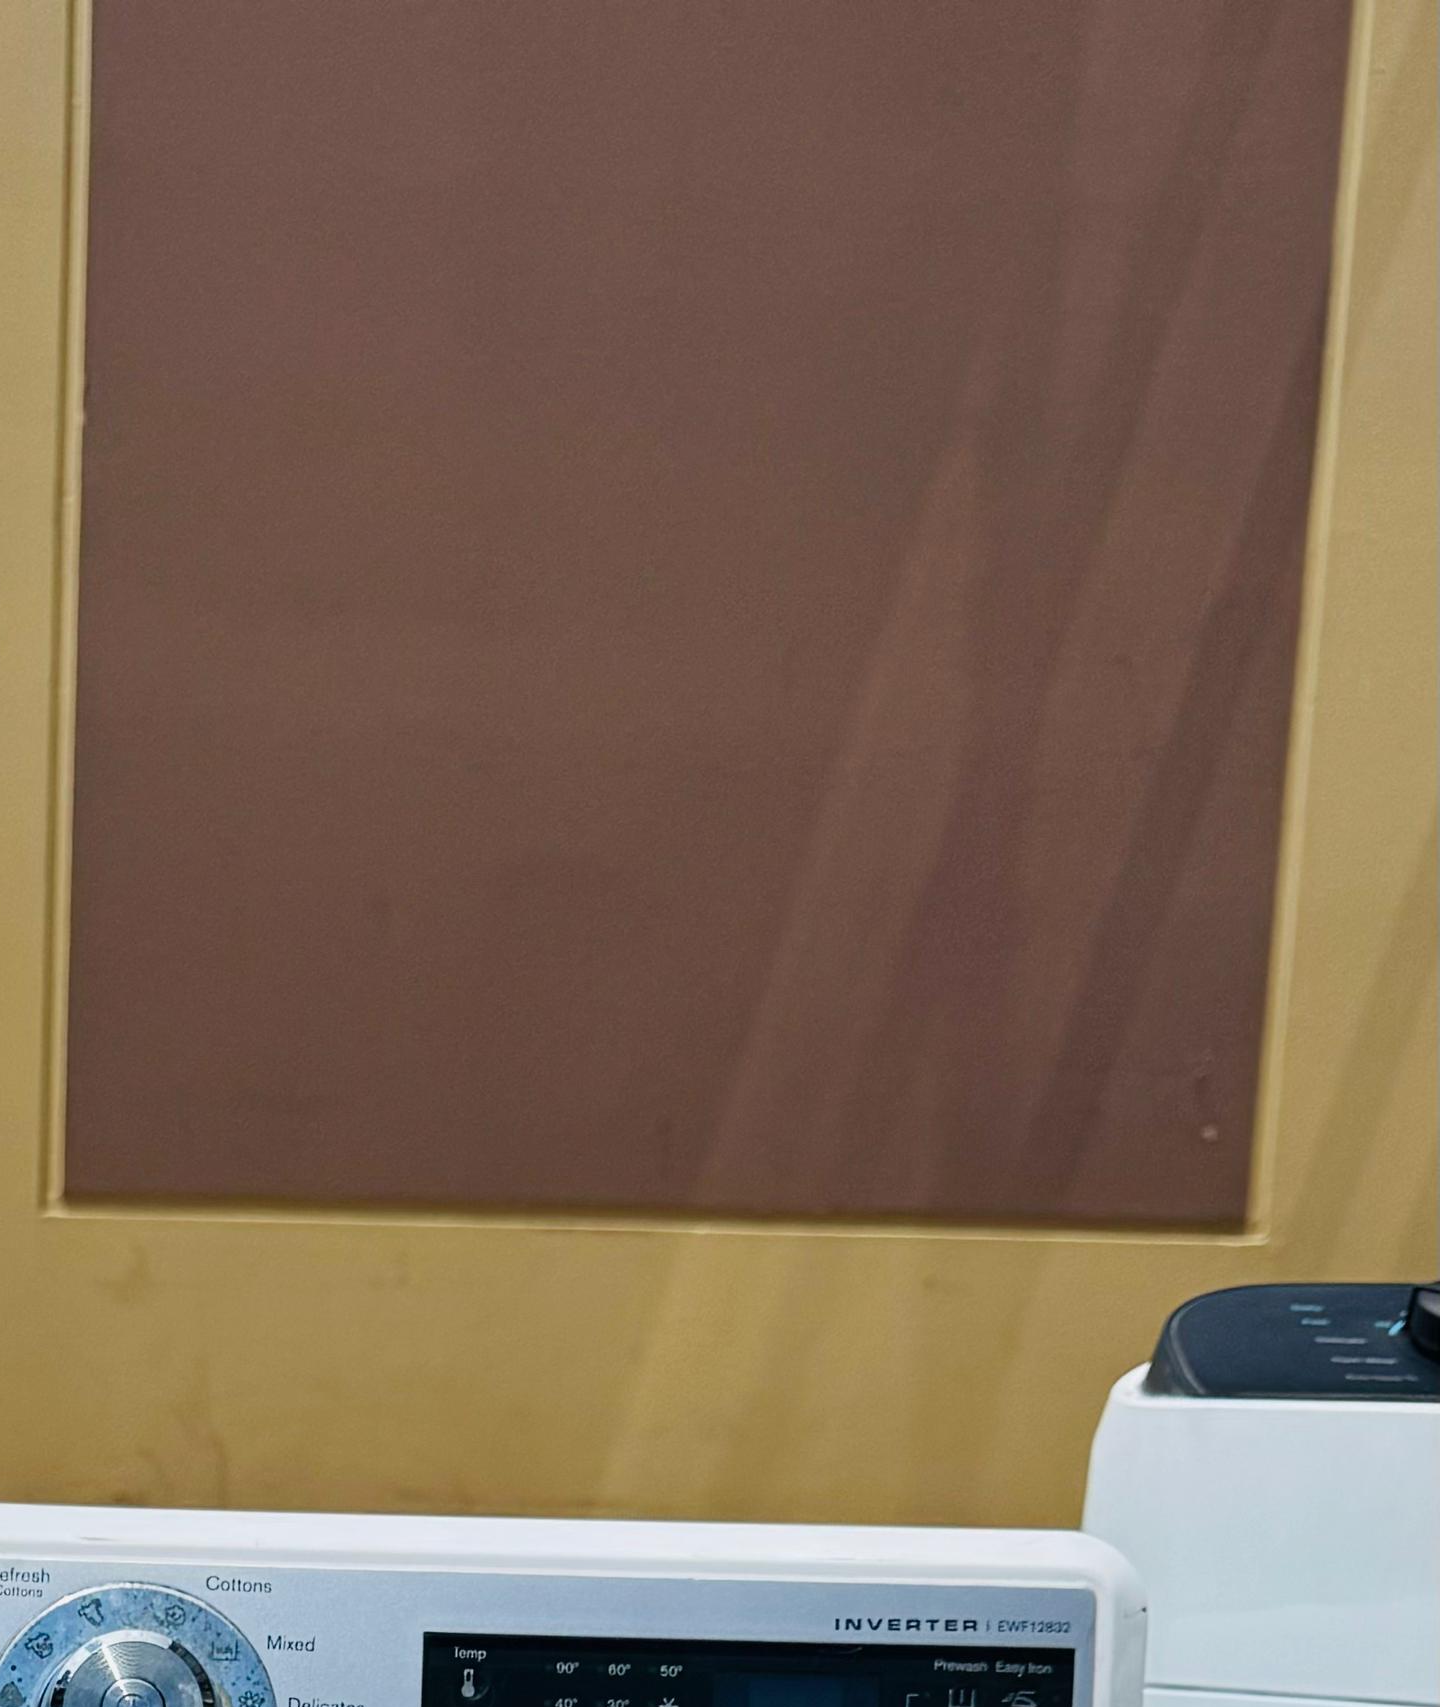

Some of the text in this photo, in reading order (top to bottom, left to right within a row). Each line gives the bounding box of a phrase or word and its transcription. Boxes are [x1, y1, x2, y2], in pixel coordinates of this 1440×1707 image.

[206, 1575, 272, 1593] Cottons
[834, 1618, 978, 1632] INVERTER
[267, 1635, 316, 1652] Mixed
[453, 1646, 487, 1661] Temp
[933, 1659, 988, 1672] Prewash
[995, 1660, 1053, 1677] Easy Iron
